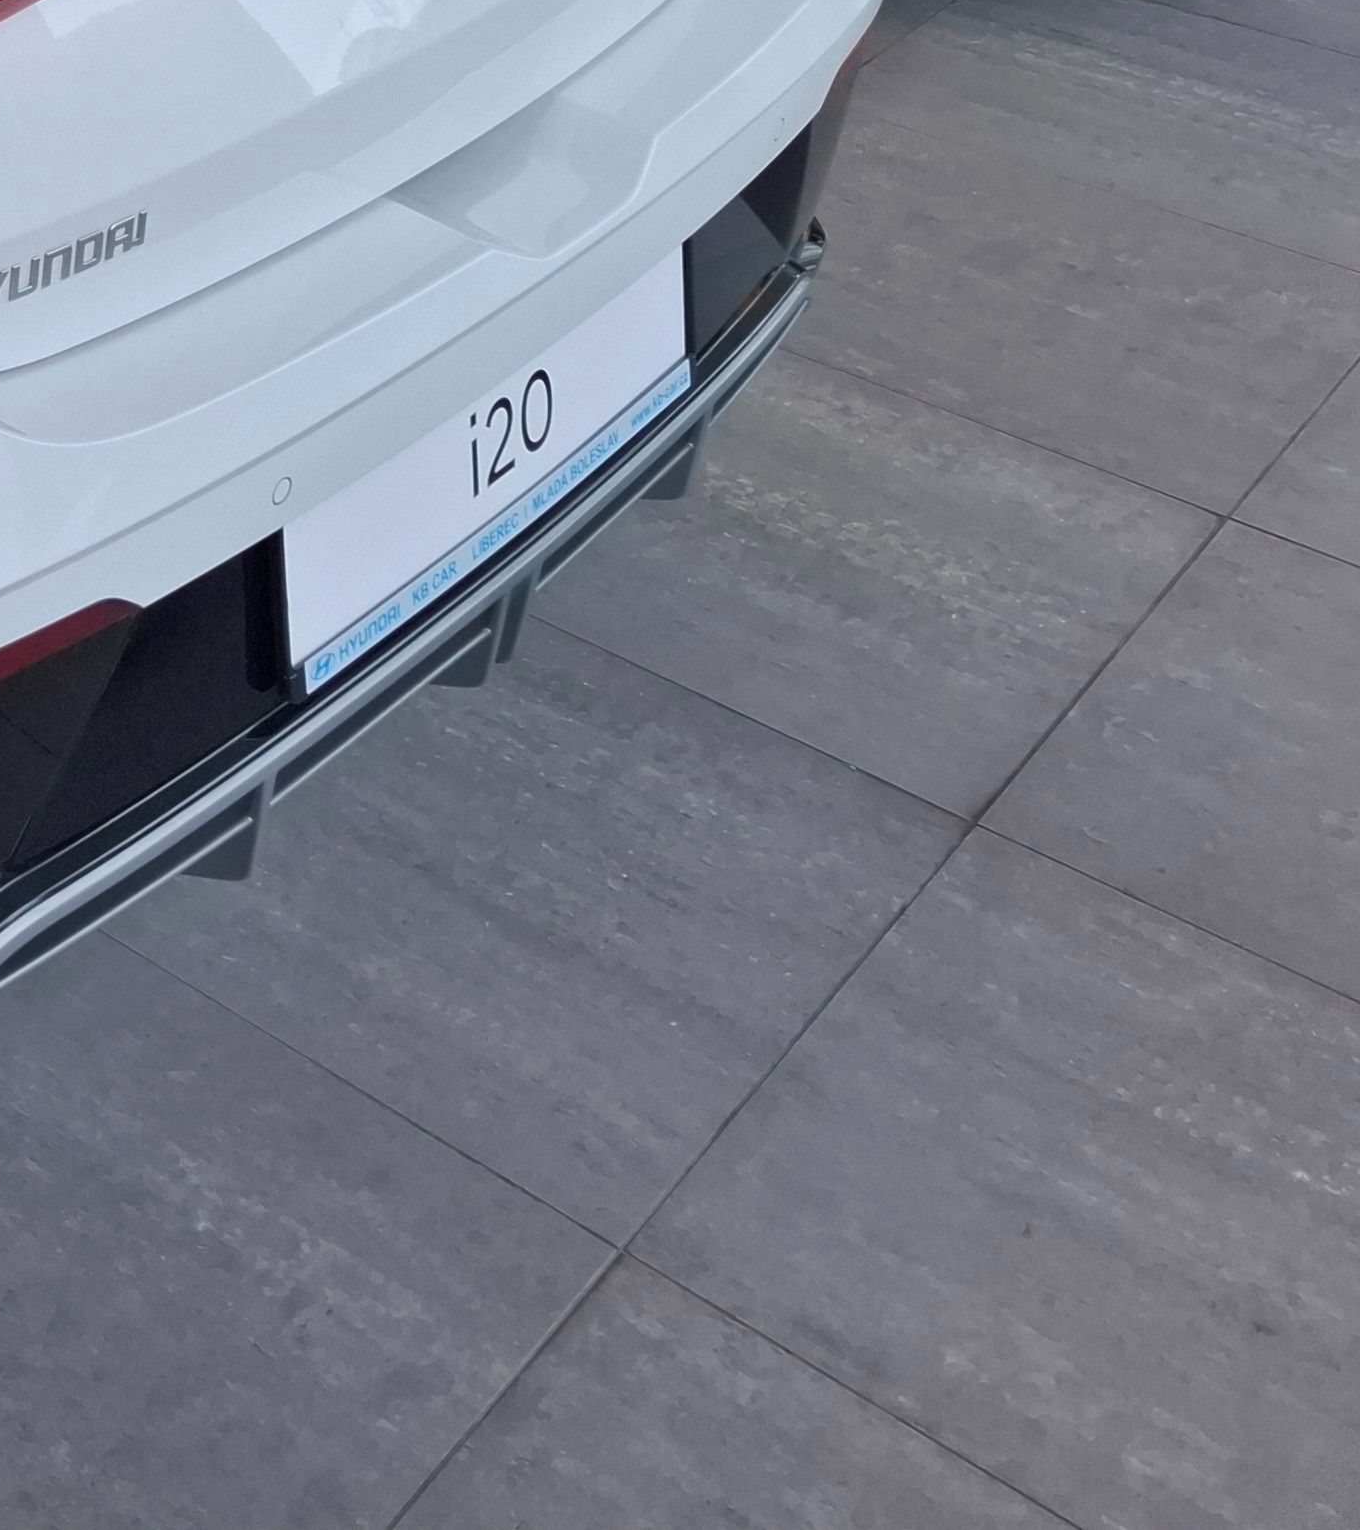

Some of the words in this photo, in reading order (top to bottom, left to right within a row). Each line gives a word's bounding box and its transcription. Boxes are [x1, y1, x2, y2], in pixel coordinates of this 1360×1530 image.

[469, 368, 553, 498] i20
[338, 602, 401, 662] HYUNDAI
[411, 581, 430, 606] KB
[431, 560, 458, 590] CAR
[471, 512, 519, 560] LIBEREC
[570, 429, 620, 483] BOLESLAV
